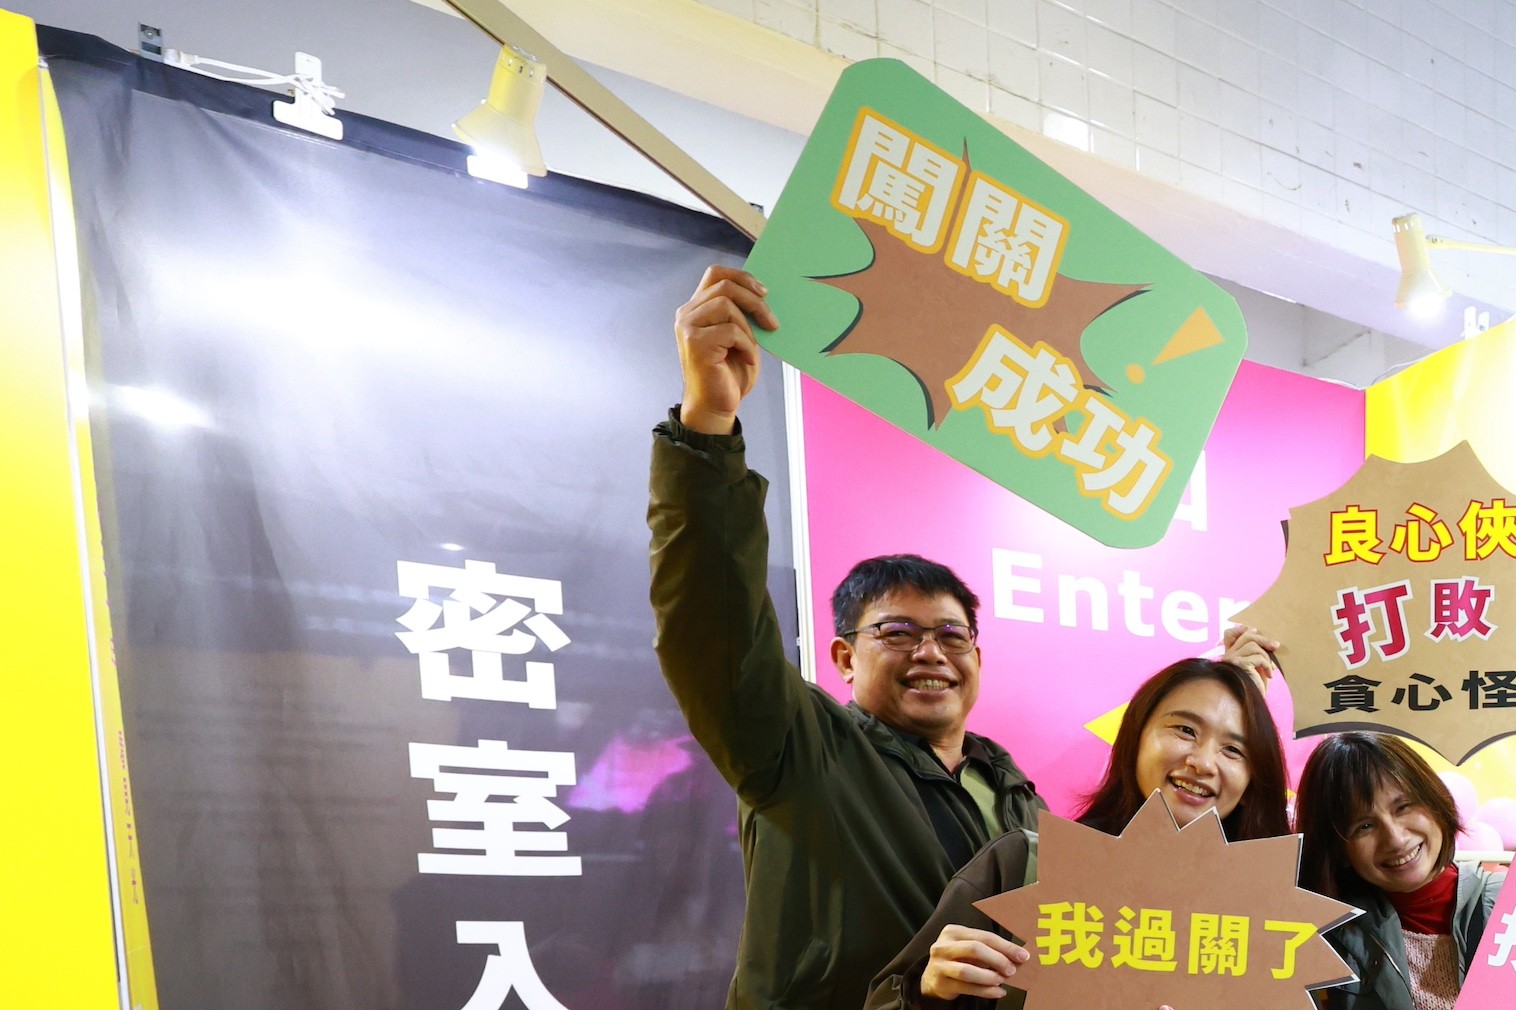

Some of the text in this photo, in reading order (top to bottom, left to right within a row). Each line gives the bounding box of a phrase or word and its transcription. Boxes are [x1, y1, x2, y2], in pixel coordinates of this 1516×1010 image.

[831, 105, 1071, 308] 闖關
[951, 323, 1173, 520] 成功
[1329, 575, 1498, 670] 打敗
[1035, 901, 1319, 980] 我過關了
